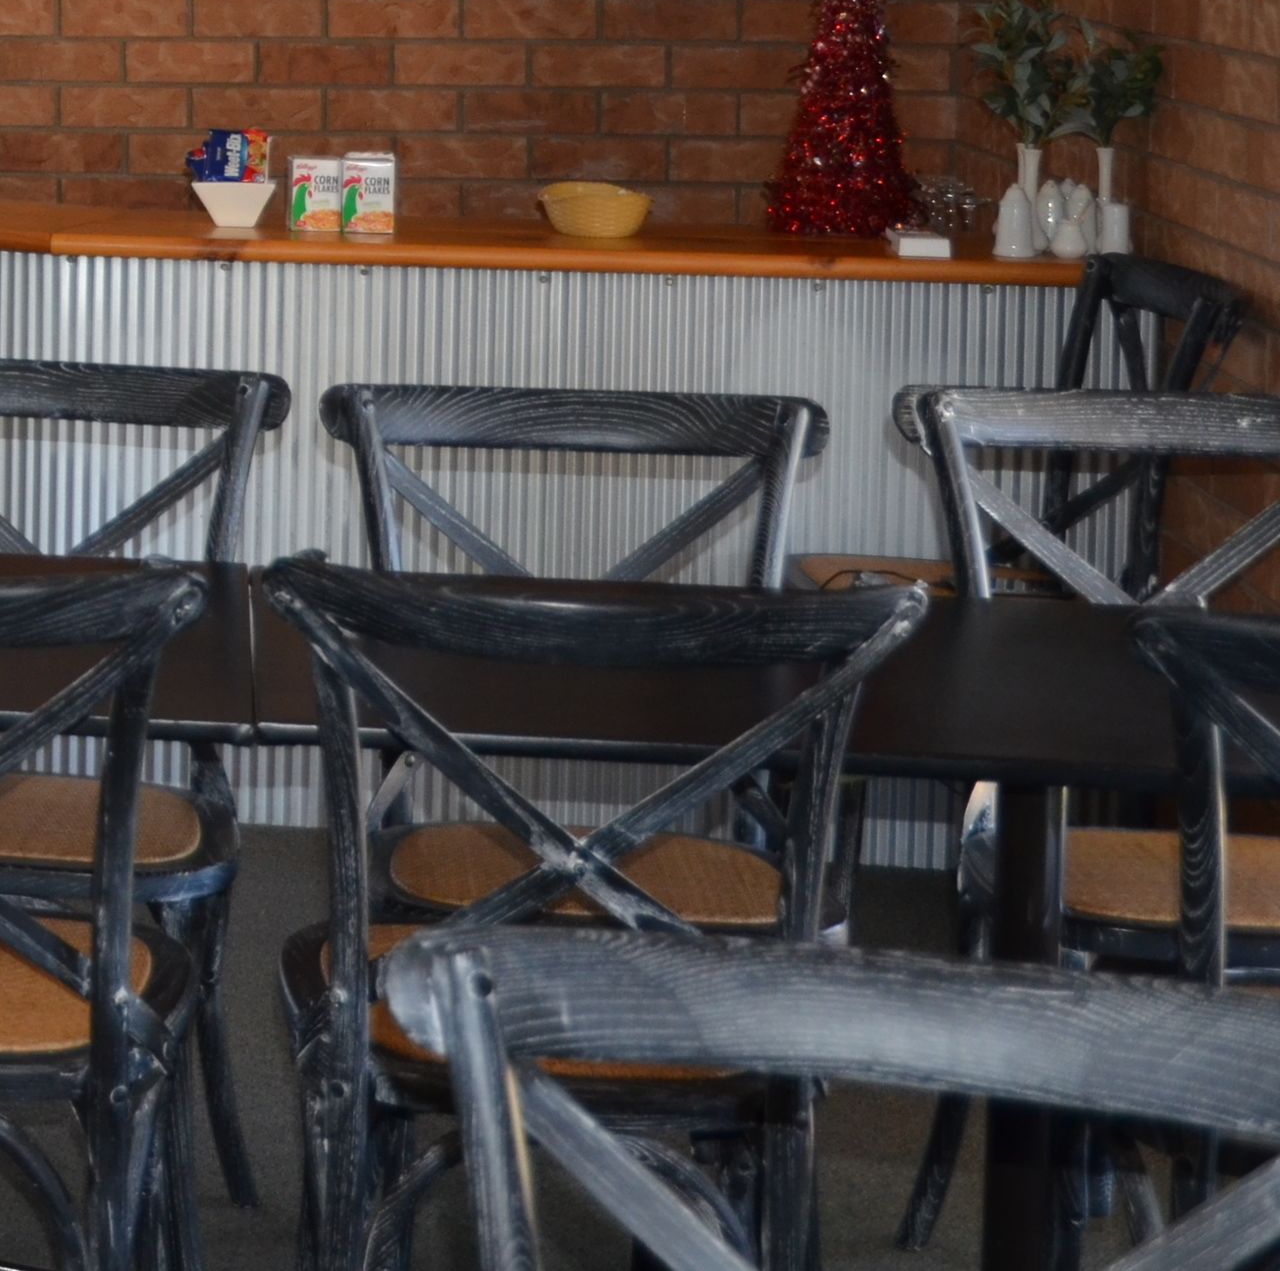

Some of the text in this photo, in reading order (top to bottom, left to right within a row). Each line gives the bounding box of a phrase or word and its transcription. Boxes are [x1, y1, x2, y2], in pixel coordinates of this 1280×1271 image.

[223, 133, 242, 177] Weet-Bix
[314, 175, 339, 185] CORN
[364, 177, 390, 186] CORN
[314, 185, 340, 193] FLAKES
[364, 186, 391, 195] FLAKES
